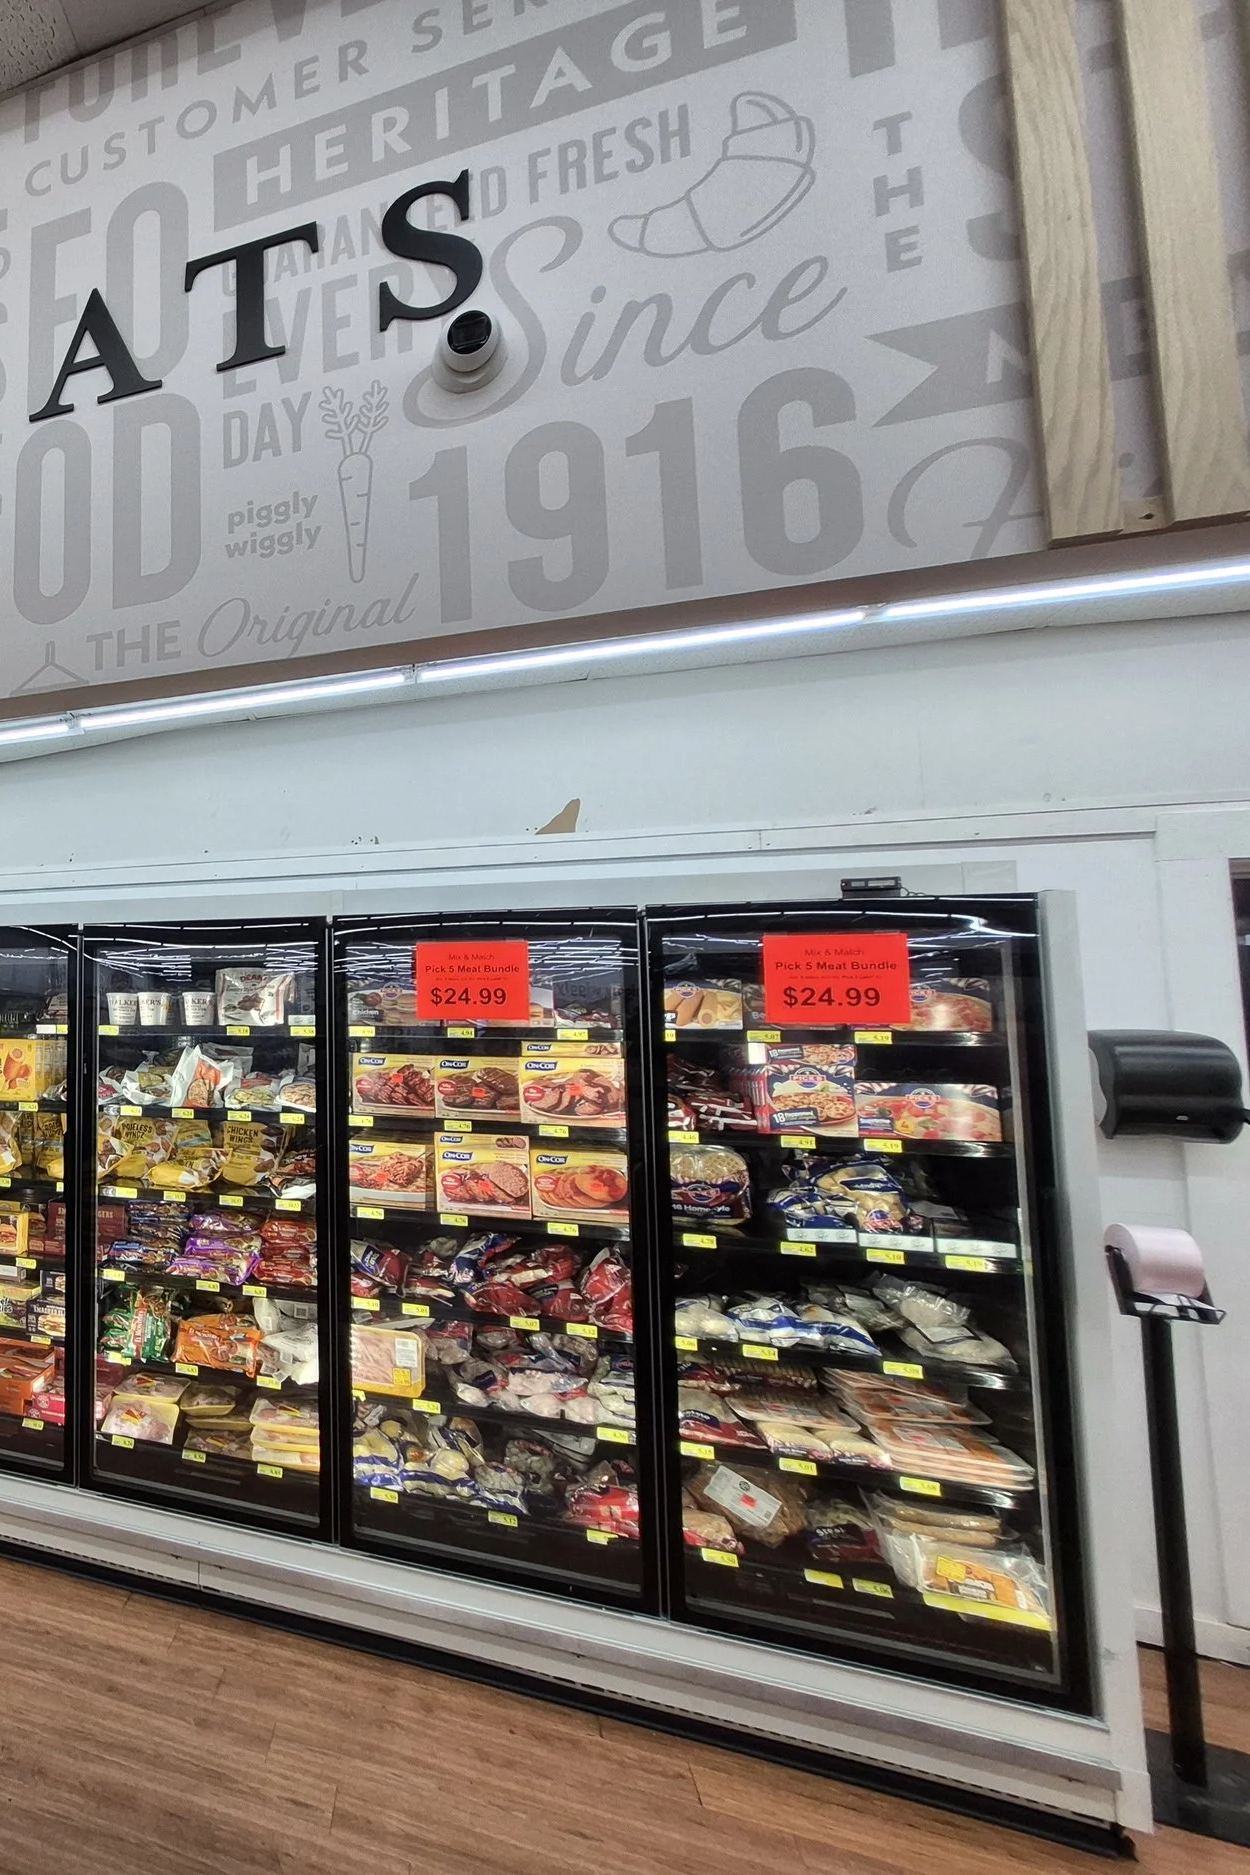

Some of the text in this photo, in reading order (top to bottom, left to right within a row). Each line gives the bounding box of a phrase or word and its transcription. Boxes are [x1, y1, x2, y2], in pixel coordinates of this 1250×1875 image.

[24, 38, 370, 198] CUSTOMER
[246, 0, 748, 208] HERITAGE
[530, 103, 692, 204] FRESH
[872, 111, 926, 274] THE
[403, 214, 848, 430] Since
[222, 391, 313, 470] DAY
[227, 491, 318, 534] piggly
[408, 367, 866, 624] 1916
[225, 521, 323, 561] wiggly
[87, 572, 420, 672] THE Original
[425, 964, 520, 974] Pick 5 Meat Bundle
[775, 961, 897, 971] Pick 5 Meat Bundle
[430, 987, 507, 1008] $24.99
[783, 986, 881, 1008] $24.99
[226, 1125, 259, 1138] CHICKEN
[772, 1111, 786, 1123] 18
[229, 1133, 254, 1144] WINGS
[684, 1204, 731, 1213] Homeyle
